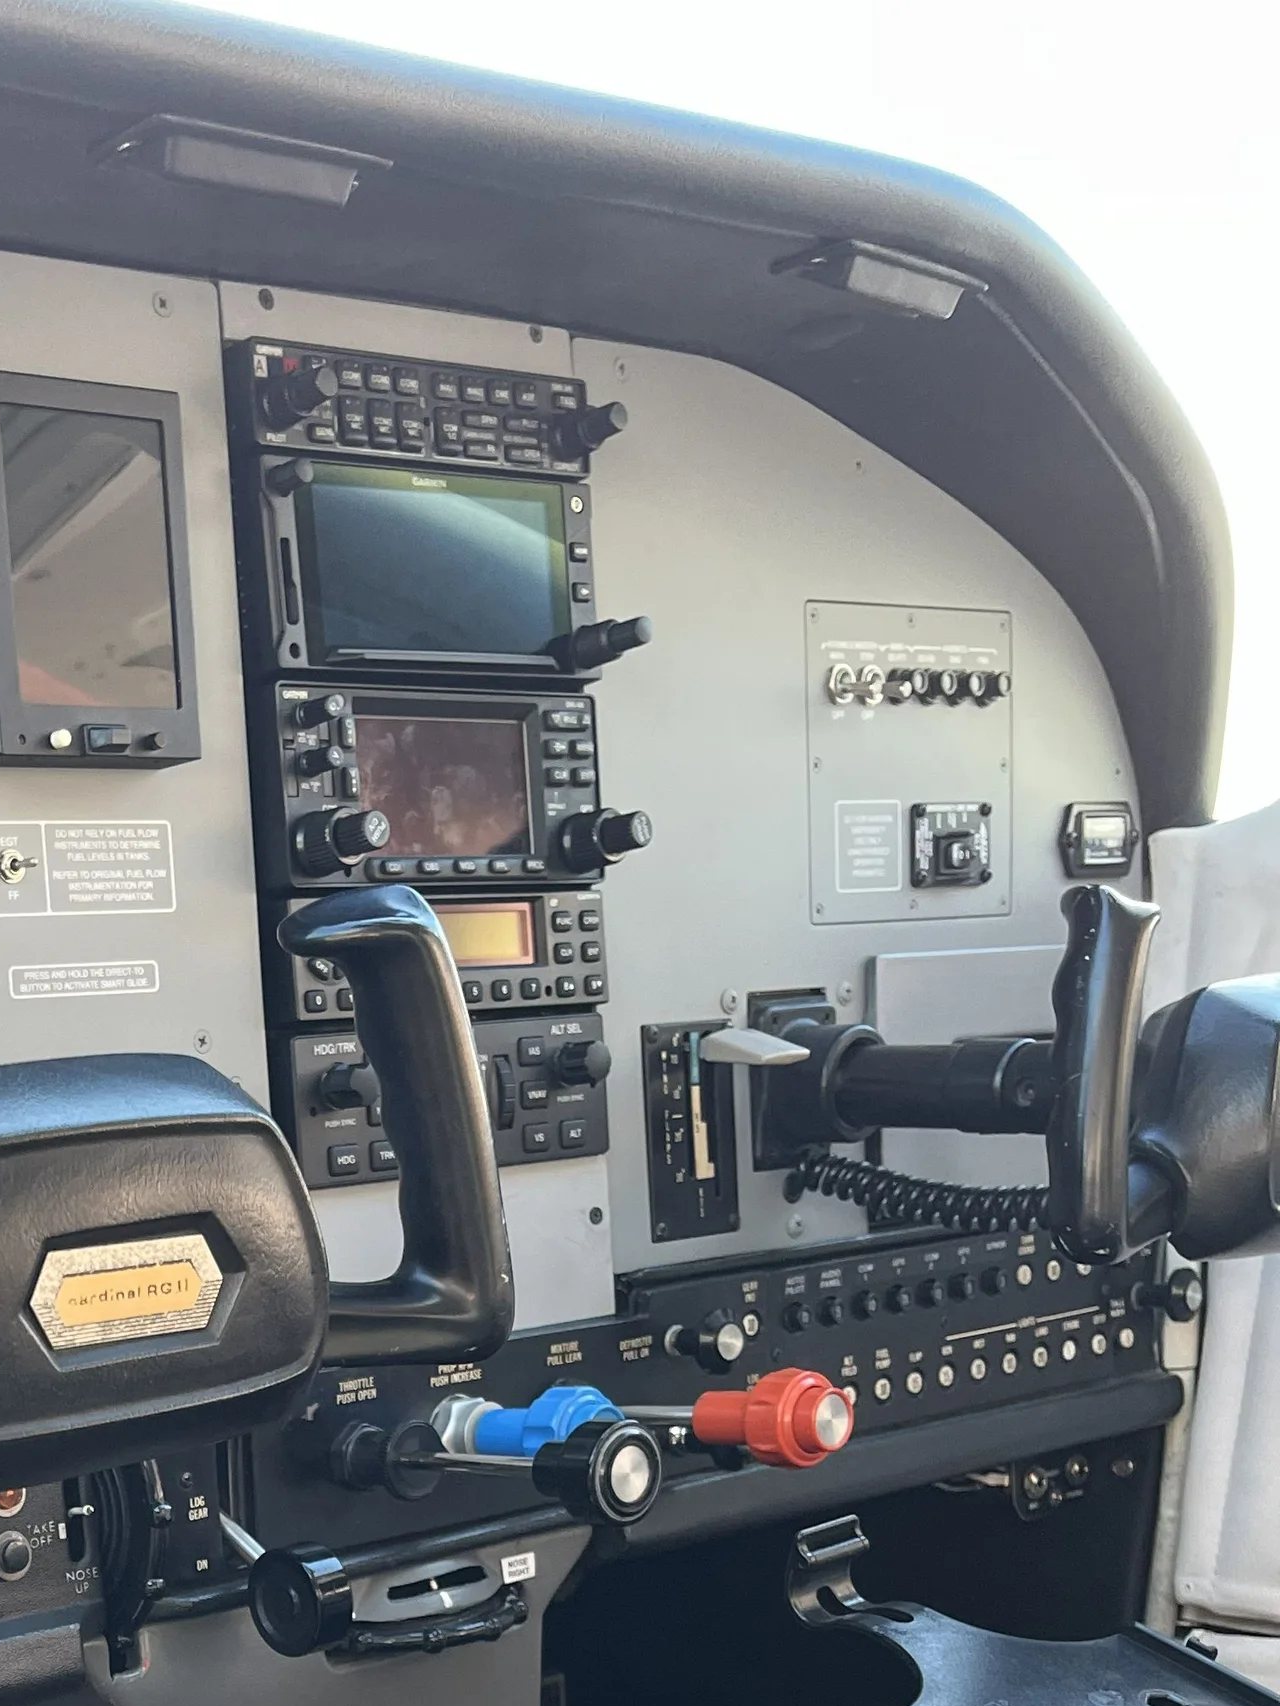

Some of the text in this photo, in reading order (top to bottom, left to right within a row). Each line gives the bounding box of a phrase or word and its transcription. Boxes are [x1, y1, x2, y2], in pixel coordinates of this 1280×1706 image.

[0, 836, 18, 848] EGT
[551, 1023, 582, 1035] ALT SEL
[313, 1041, 357, 1056] HDG/TRK
[528, 1046, 541, 1056] IAS
[534, 1133, 545, 1143] VS
[570, 1128, 582, 1138] ALT
[337, 1155, 356, 1167] HDG
[379, 1151, 396, 1161] TRK
[147, 1282, 172, 1297] RG
[338, 1376, 375, 1393] THROTTLE
[430, 1369, 482, 1388] PUSH INCREASE
[336, 1388, 377, 1405] PUSH OPEN
[189, 1495, 206, 1509] LDG
[188, 1507, 209, 1522] GEAR
[27, 1520, 55, 1536] TAKE
[30, 1536, 53, 1549] OFF
[196, 1559, 209, 1571] DN
[65, 1566, 99, 1582] NOSE
[75, 1582, 90, 1595] UP
